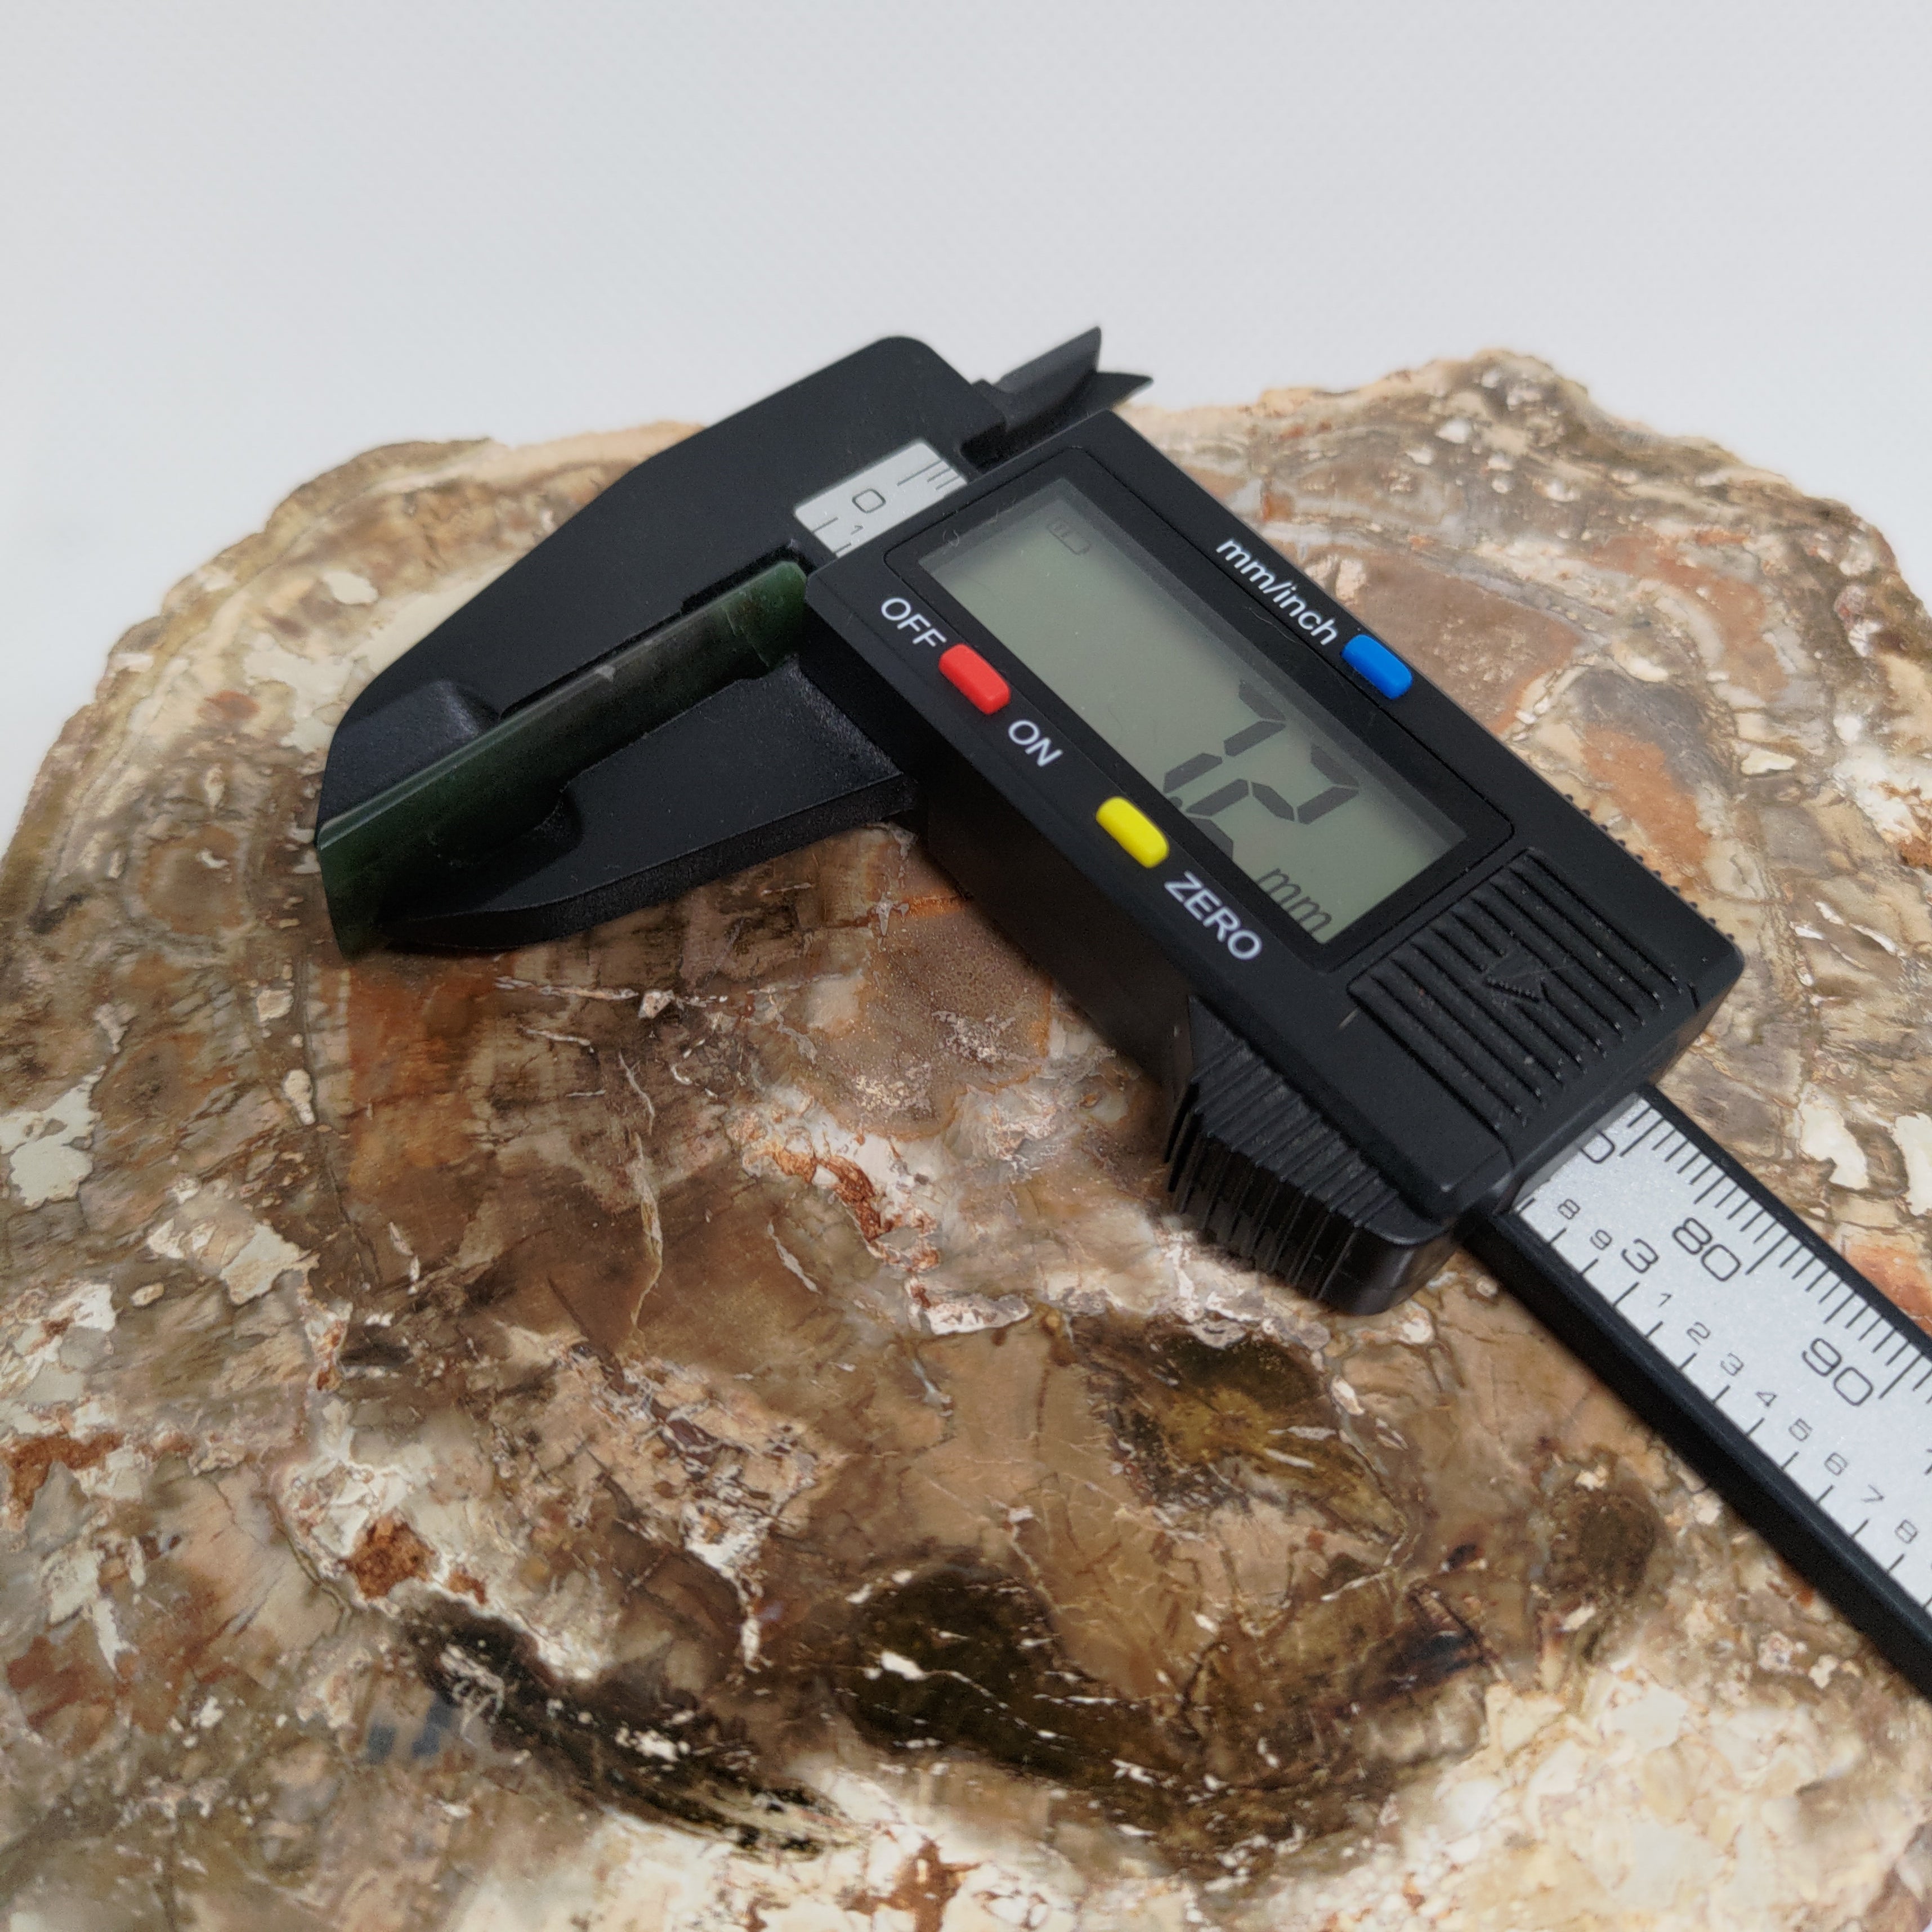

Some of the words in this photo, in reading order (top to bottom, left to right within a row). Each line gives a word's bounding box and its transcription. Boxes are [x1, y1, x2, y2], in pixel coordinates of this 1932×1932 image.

[851, 488, 886, 513] 0
[1216, 539, 1338, 646] mm/inch
[880, 597, 947, 647] OFF
[1008, 719, 1063, 767] ON
[1257, 867, 1332, 936] mm
[1164, 871, 1263, 959] ZERO
[1557, 1198, 1581, 1220] 8
[1589, 1229, 1613, 1251] 9
[1672, 1217, 1741, 1282] 80
[1620, 1238, 1659, 1274] 3
[1658, 1293, 1672, 1308] 1
[1687, 1322, 1711, 1345] 2
[1720, 1352, 1745, 1376] 3
[1801, 1338, 1874, 1406] 90
[1755, 1390, 1778, 1407] 4
[1788, 1418, 1813, 1441] 5
[1824, 1452, 1848, 1476] 6
[1861, 1484, 1885, 1504] 7
[1894, 1519, 1918, 1544] 8
